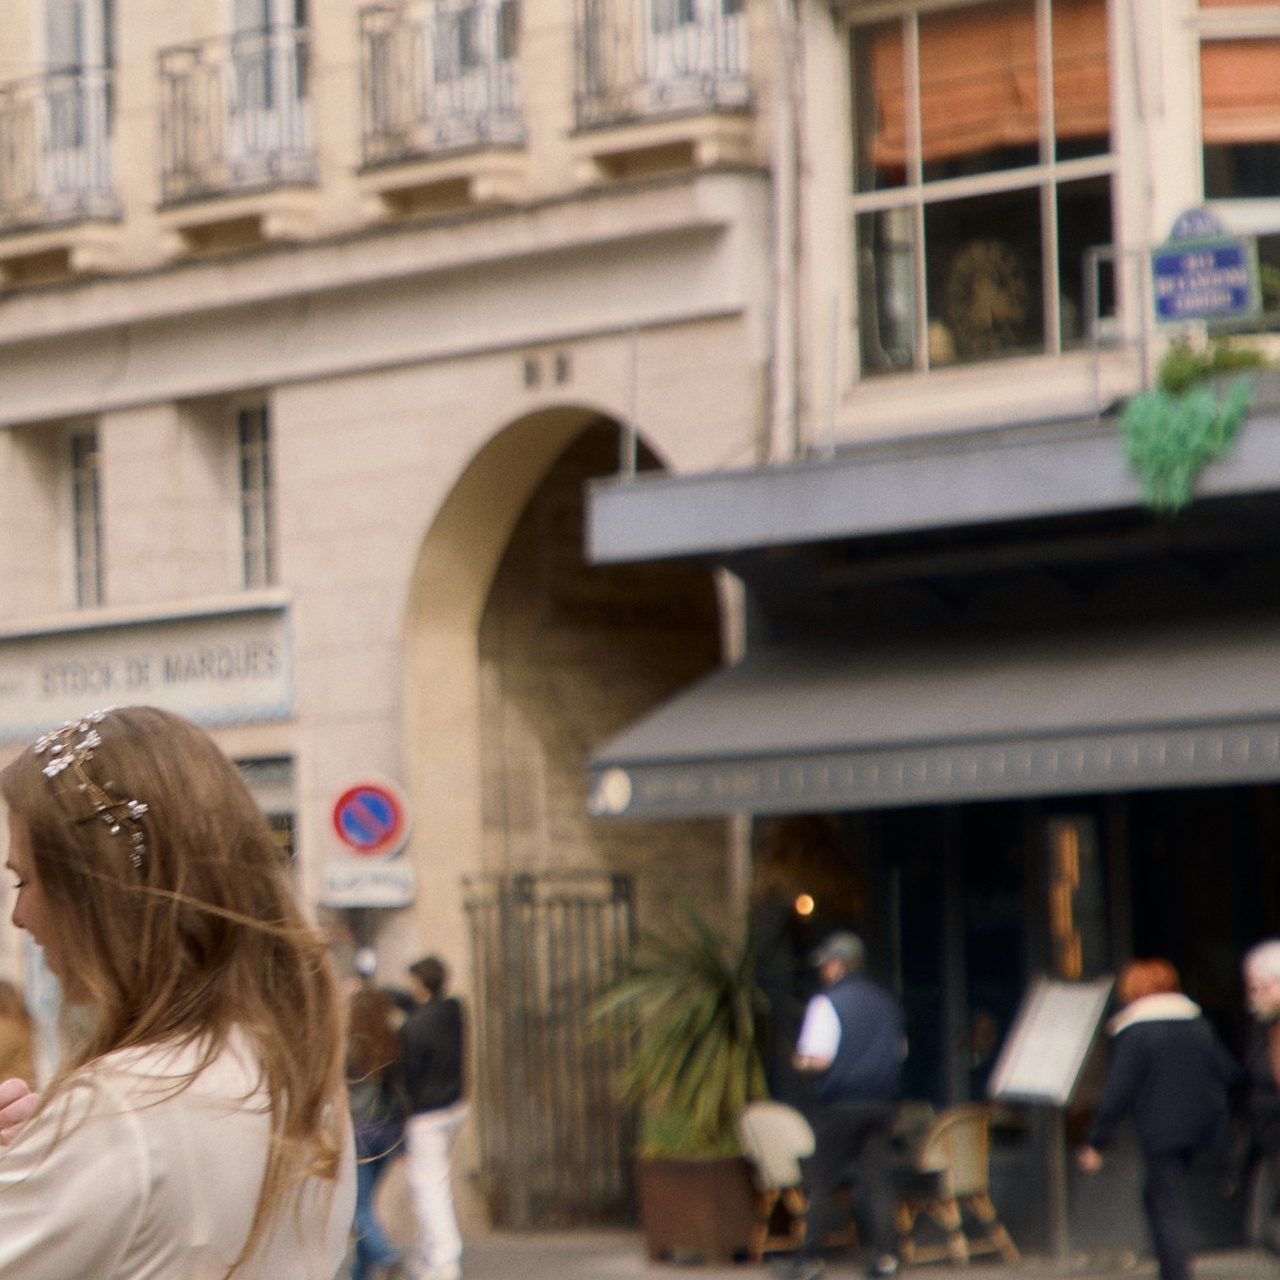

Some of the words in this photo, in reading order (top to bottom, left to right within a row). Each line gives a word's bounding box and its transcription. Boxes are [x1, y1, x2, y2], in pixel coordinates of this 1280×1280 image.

[40, 661, 114, 700] STOCK
[125, 654, 153, 692] DE
[162, 640, 278, 685] MARQUES
